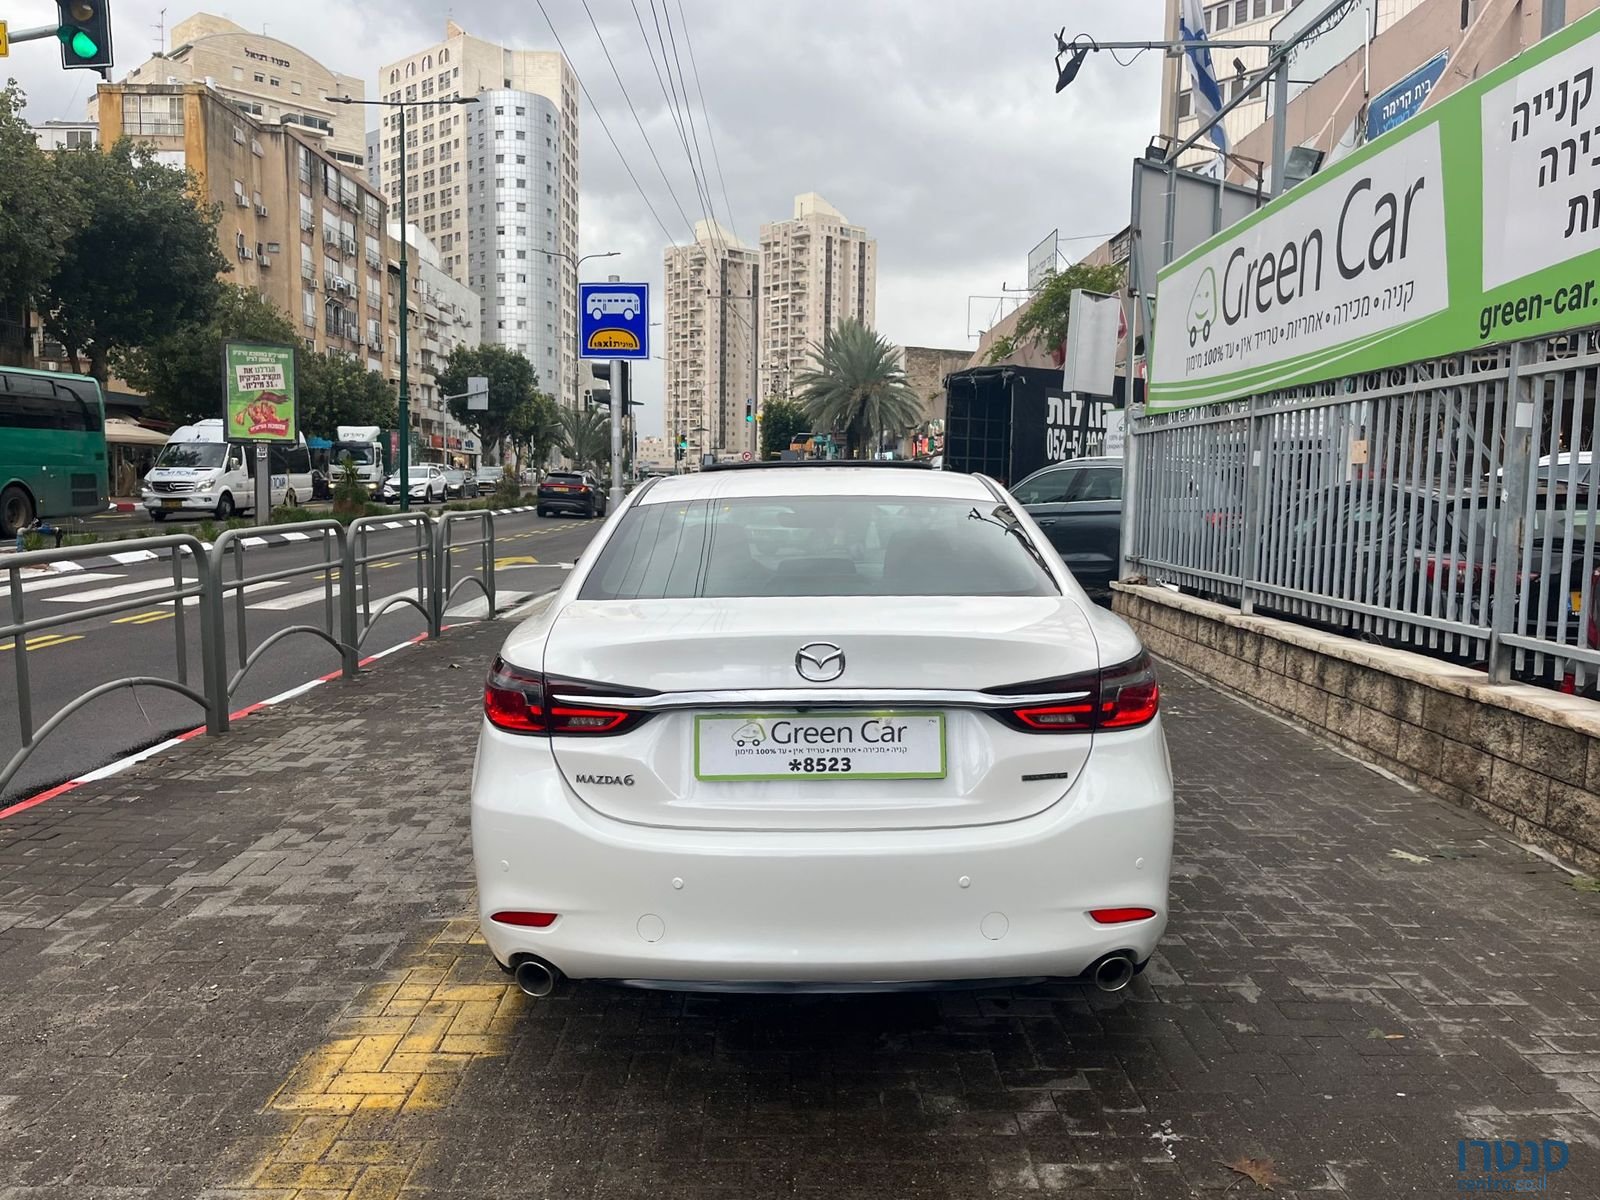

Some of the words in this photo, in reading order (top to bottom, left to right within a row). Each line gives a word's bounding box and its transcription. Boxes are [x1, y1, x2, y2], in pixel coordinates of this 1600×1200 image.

[1414, 79, 1431, 100] בית
[1511, 66, 1593, 142] קנייה
[1222, 228, 1323, 326] Green
[1336, 176, 1425, 280] Car
[1382, 280, 1414, 312] קניה
[1333, 295, 1369, 326] מכירה
[1254, 326, 1279, 350] טרייד
[1285, 311, 1323, 341] אחריות
[1204, 345, 1223, 366] 100%
[1225, 342, 1235, 359] עד
[1240, 335, 1252, 360] אין
[1186, 353, 1202, 376] מימון
[239, 374, 260, 383] הניקיון
[261, 373, 281, 381] תקציב
[770, 721, 853, 744] Green
[861, 720, 908, 743] Car
[735, 748, 754, 756] מימון
